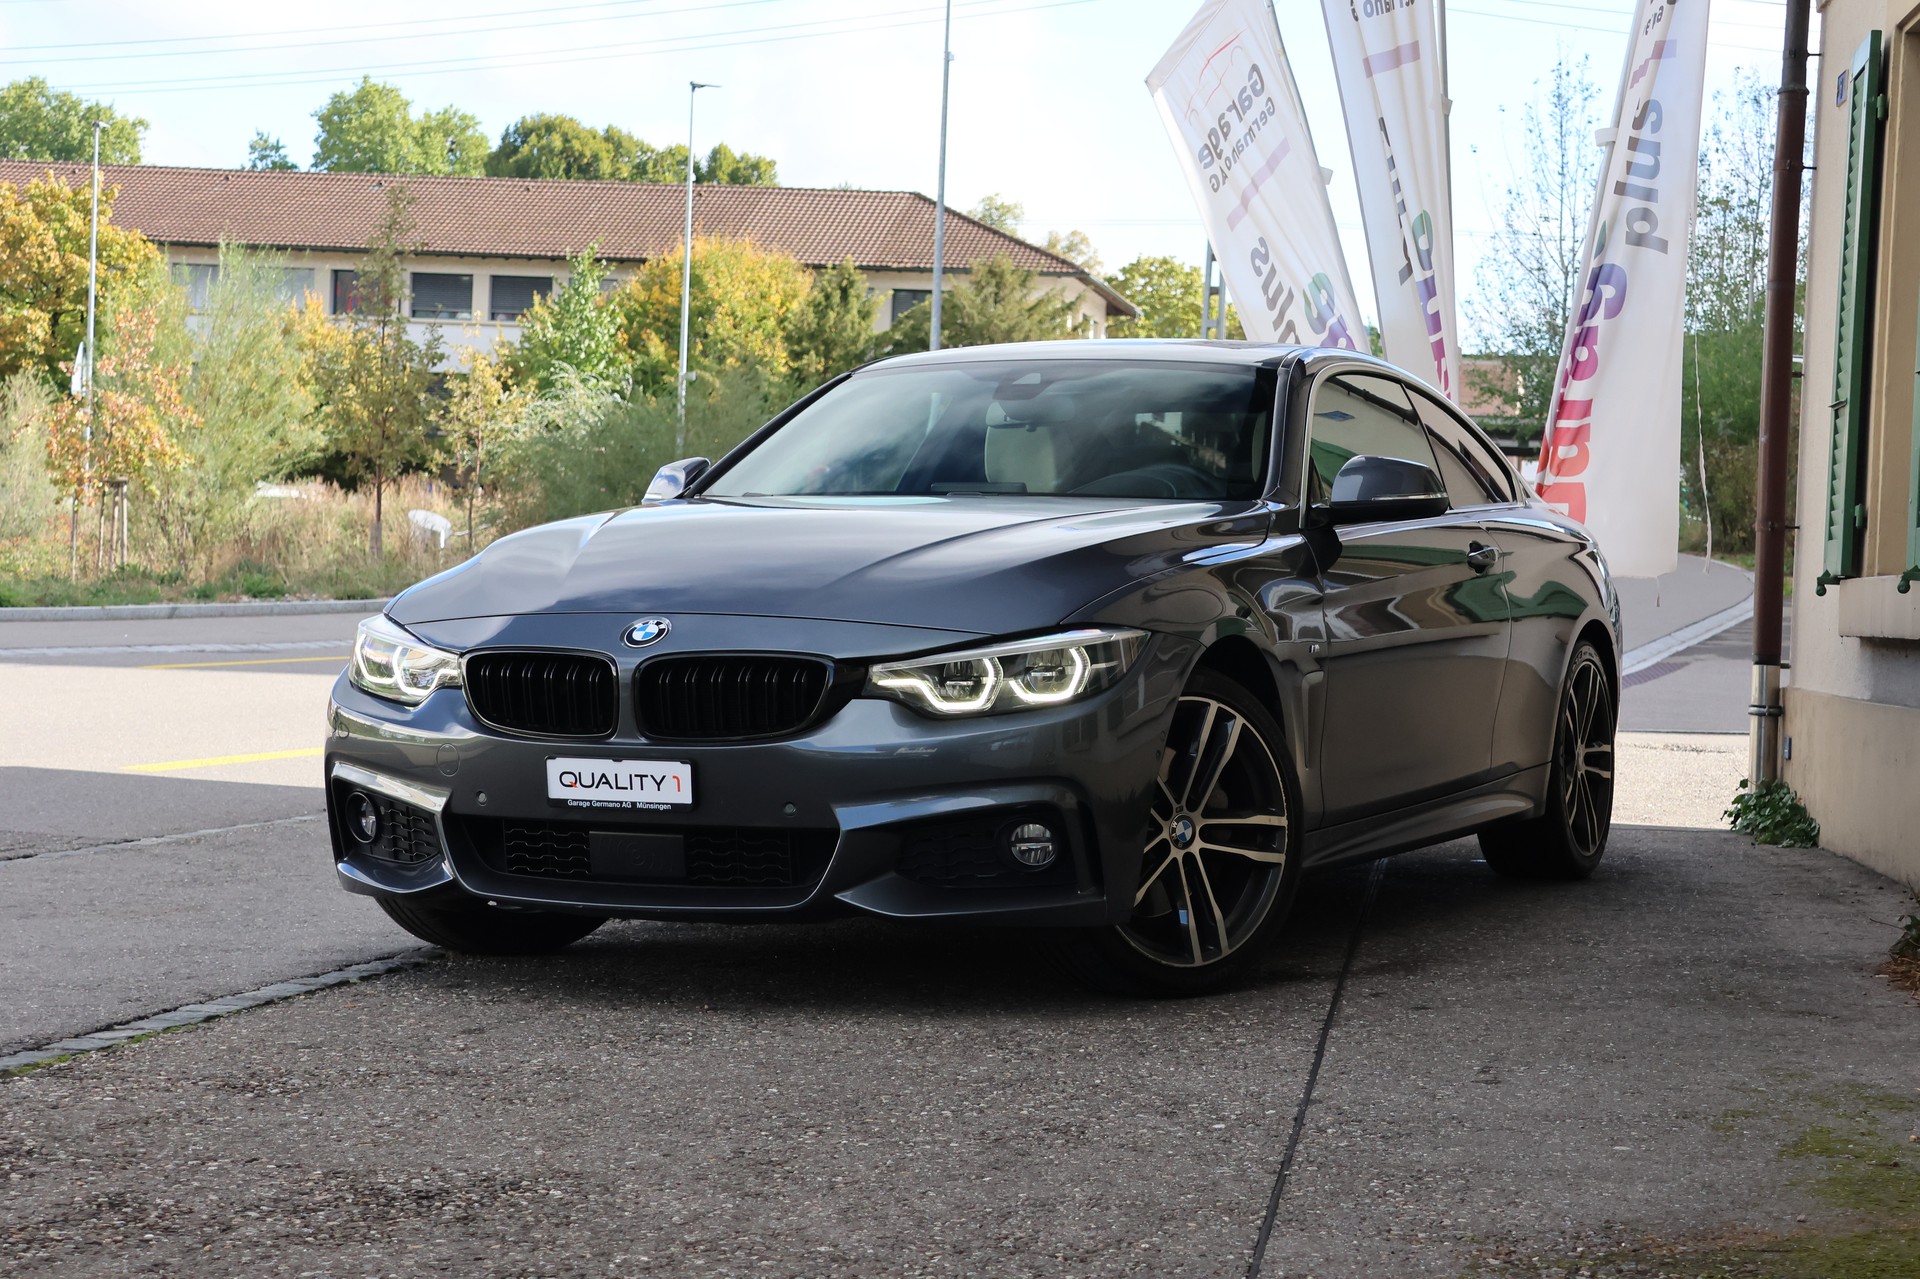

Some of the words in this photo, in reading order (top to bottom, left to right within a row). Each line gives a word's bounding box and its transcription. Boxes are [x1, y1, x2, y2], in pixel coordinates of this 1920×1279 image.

[1614, 98, 1669, 256] plus
[559, 771, 667, 791] QUALITY
[672, 775, 681, 793] 1
[567, 799, 591, 808] Garage
[591, 800, 621, 808] Germano
[636, 801, 672, 811] Münsingen
